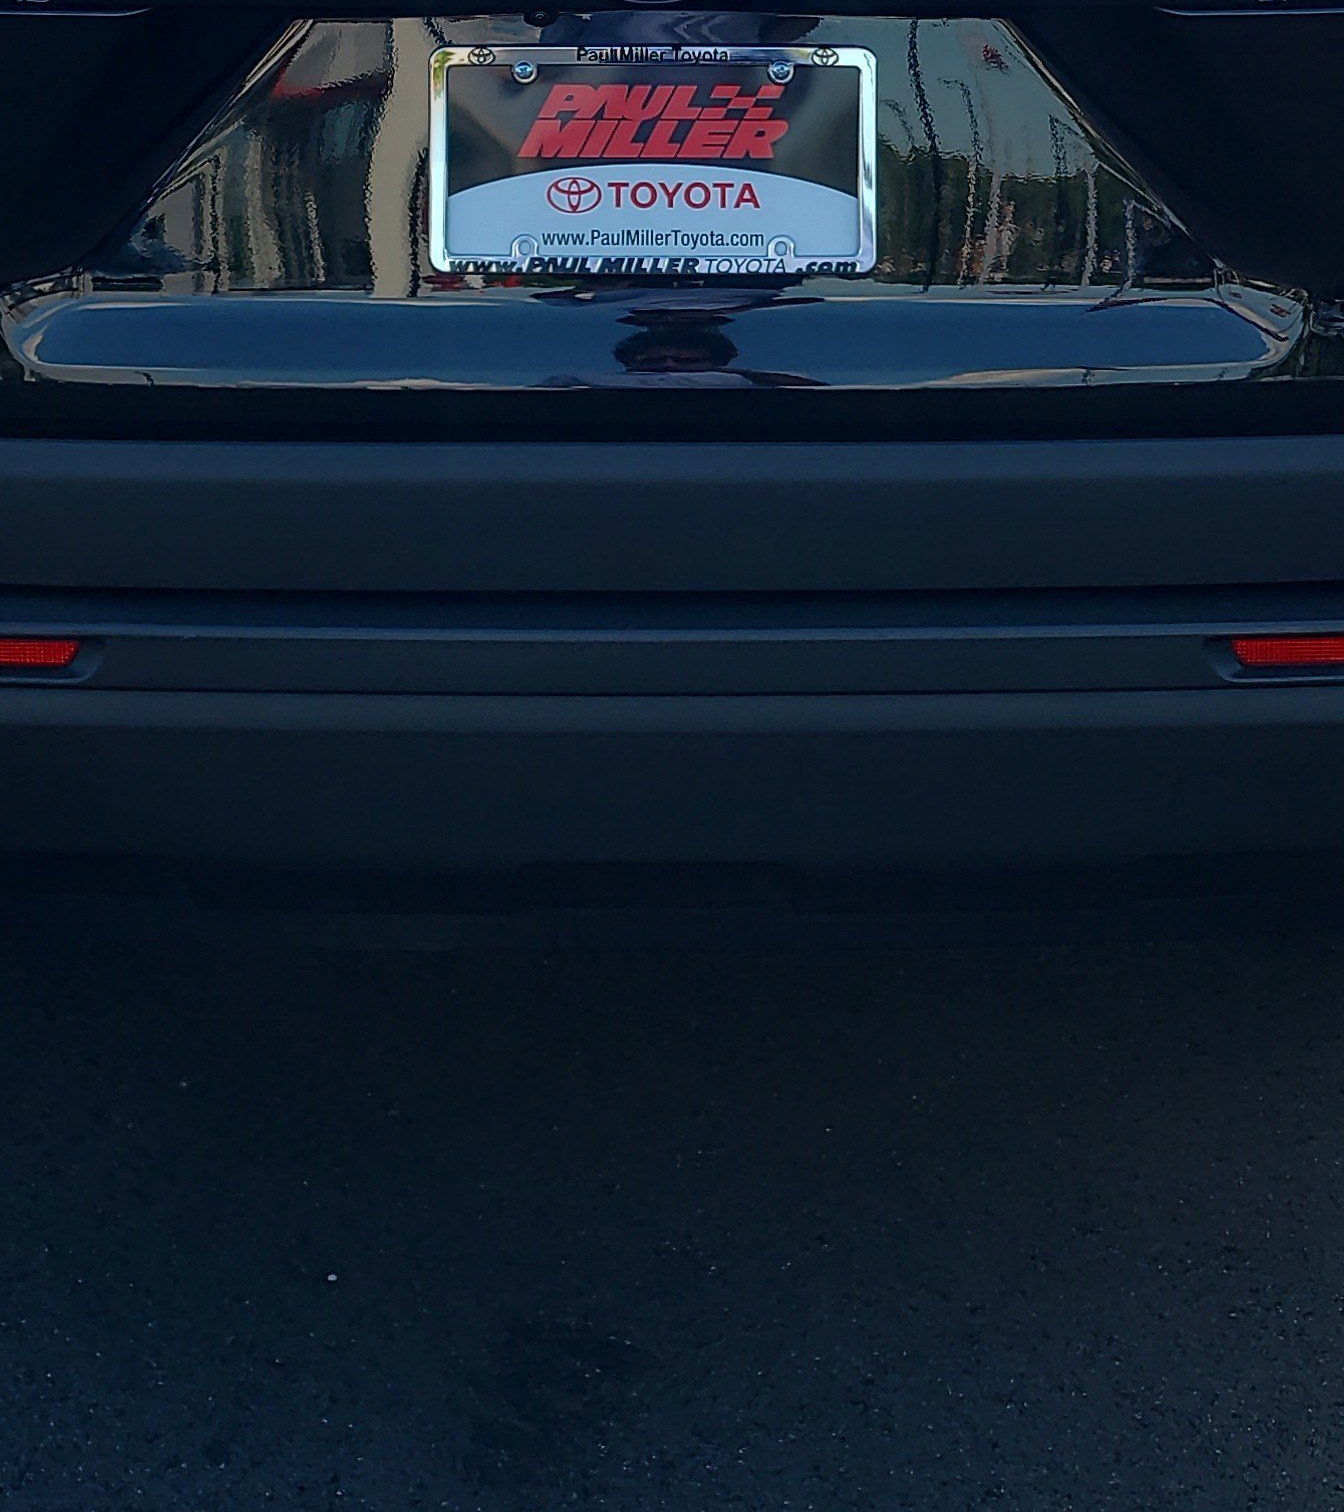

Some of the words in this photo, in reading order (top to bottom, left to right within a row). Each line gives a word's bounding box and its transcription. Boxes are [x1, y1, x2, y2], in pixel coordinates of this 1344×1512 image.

[576, 45, 618, 63] Paul
[619, 45, 666, 63] Miller
[672, 45, 730, 65] Toyota
[538, 84, 702, 120] PAUL
[518, 119, 790, 159] MILLER
[607, 181, 762, 209] TOYOTA
[541, 229, 764, 250] www.PaulMillerToyota.com
[598, 257, 700, 273] MILLER
[704, 258, 786, 273] TOYOTA
